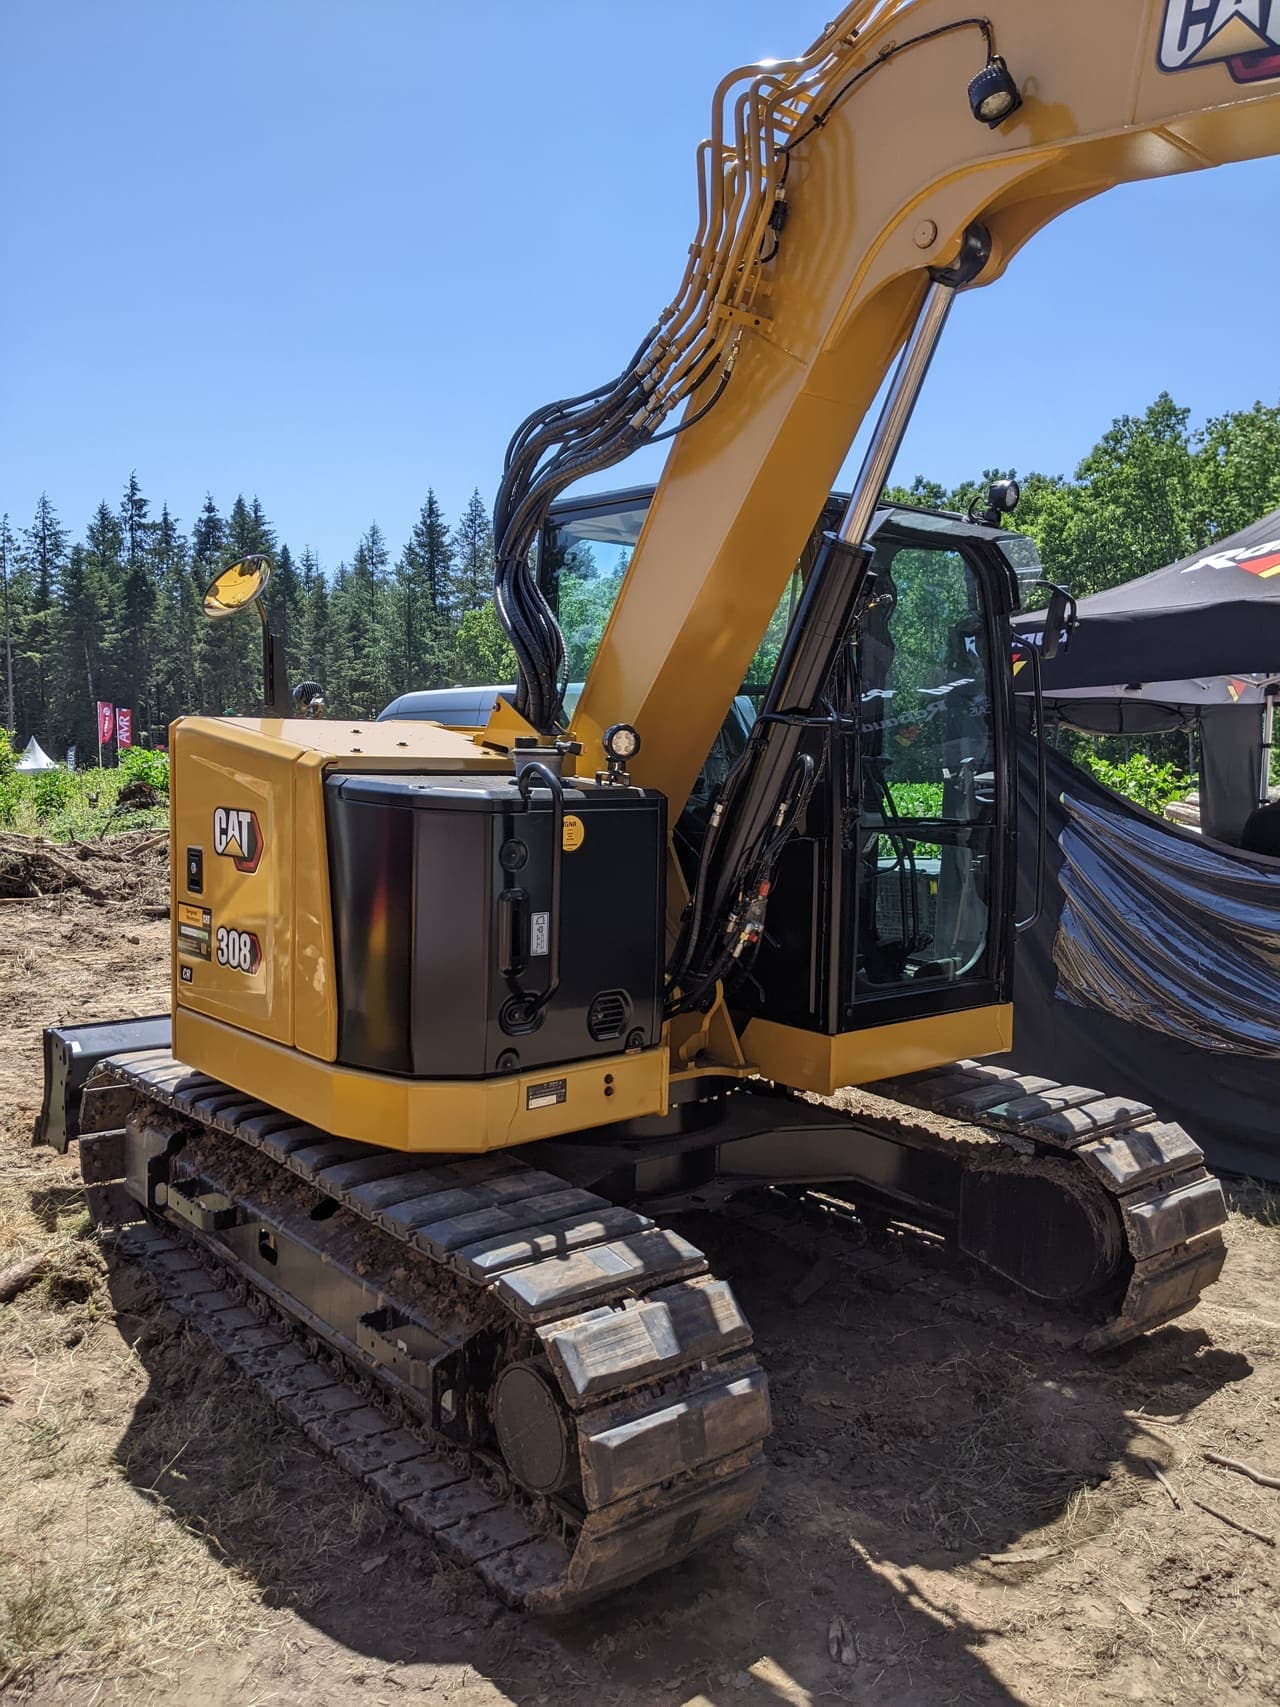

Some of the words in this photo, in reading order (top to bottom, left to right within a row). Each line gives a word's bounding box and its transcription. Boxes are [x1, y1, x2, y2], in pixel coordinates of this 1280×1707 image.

[1159, 0, 1280, 68] CA
[214, 808, 251, 858] CAT
[217, 927, 251, 970] 308
[182, 967, 191, 981] CR
